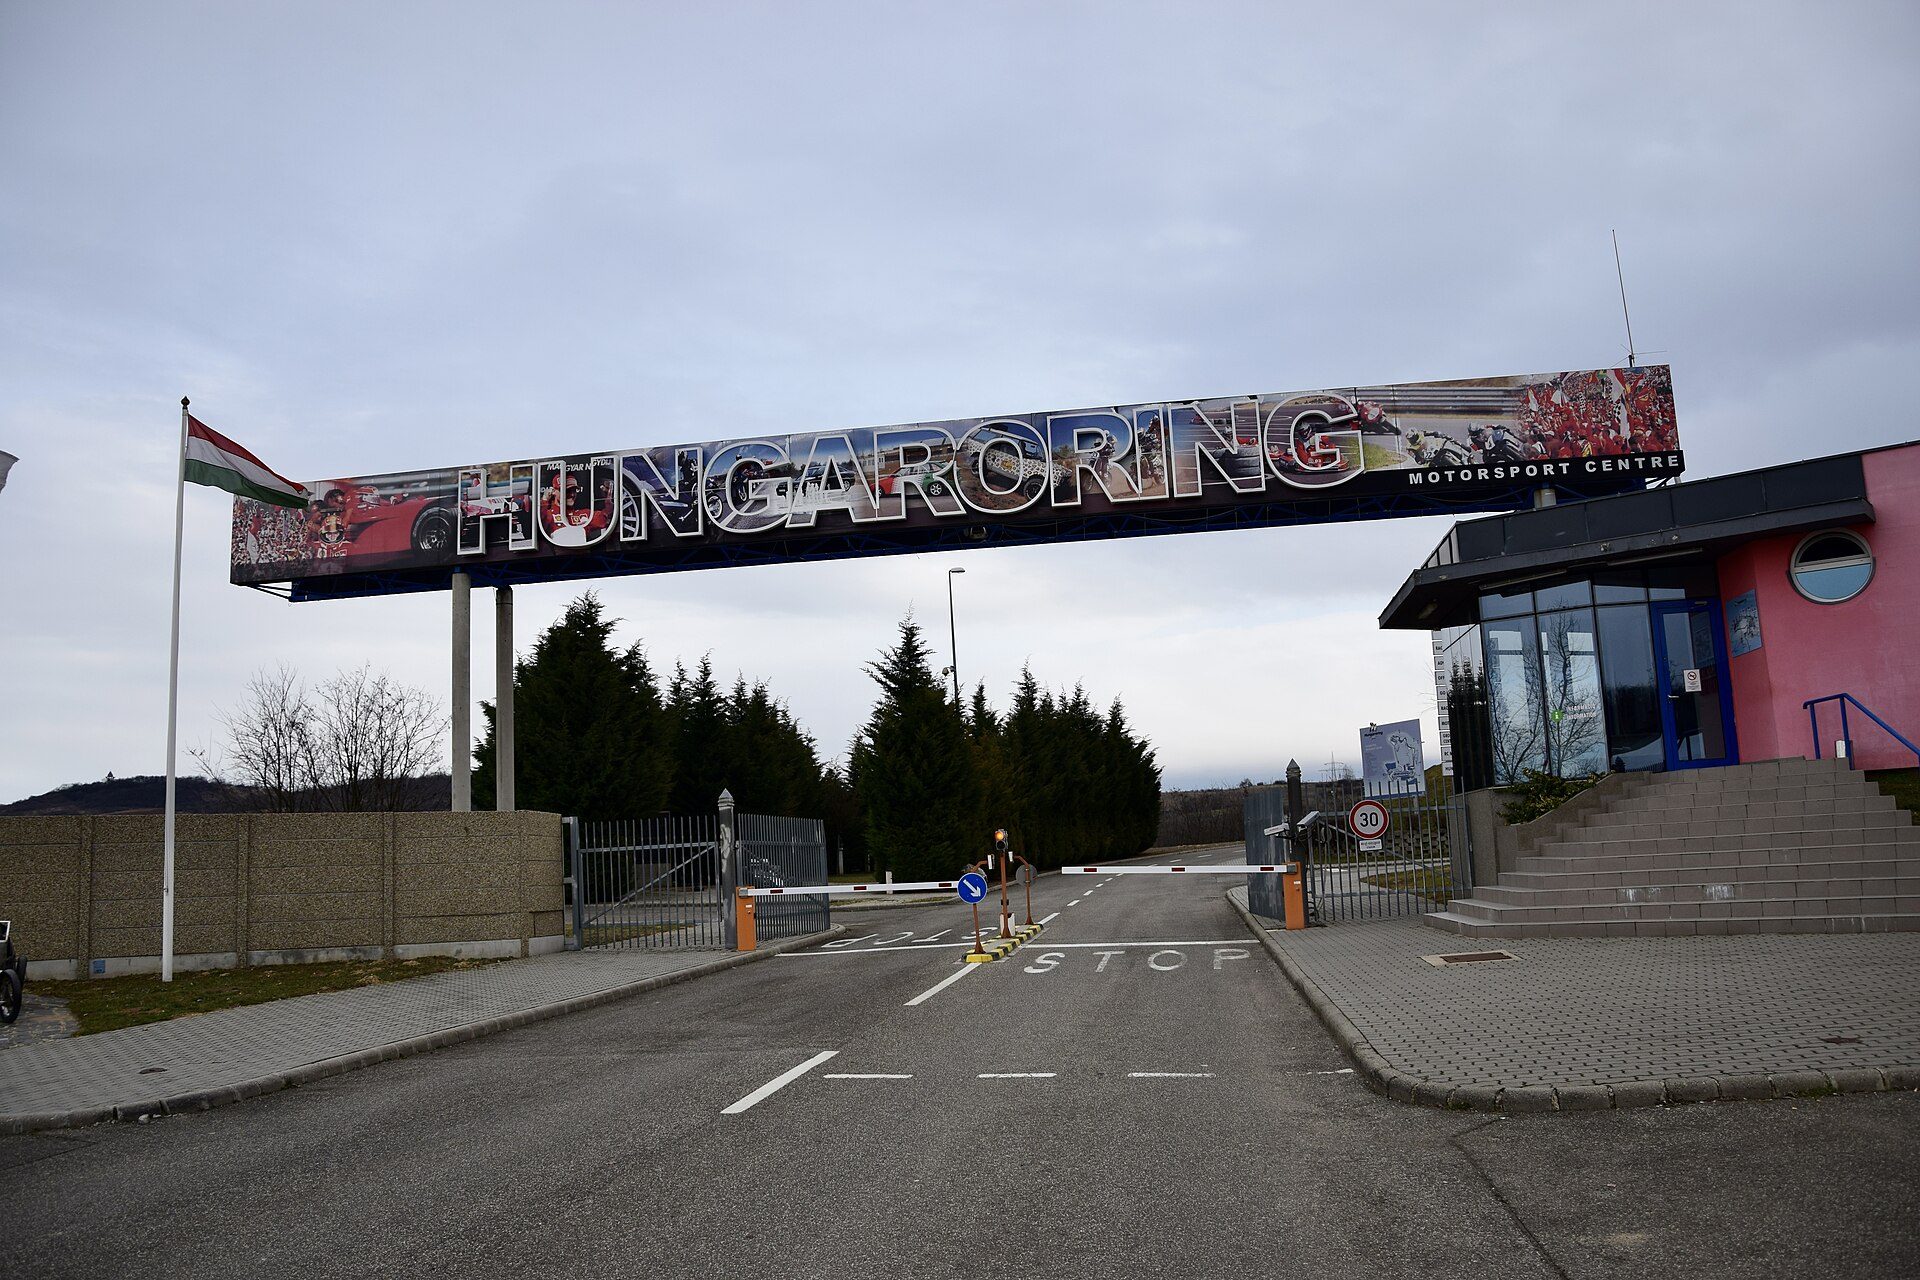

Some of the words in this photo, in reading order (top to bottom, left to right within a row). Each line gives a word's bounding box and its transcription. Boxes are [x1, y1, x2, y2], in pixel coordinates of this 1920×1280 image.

[456, 391, 1365, 556] HUNGARORING
[1408, 462, 1570, 485] MOTORSPORT
[1585, 455, 1680, 473] CENTRE
[1360, 812, 1378, 827] 30
[1024, 949, 1250, 973] STOP
